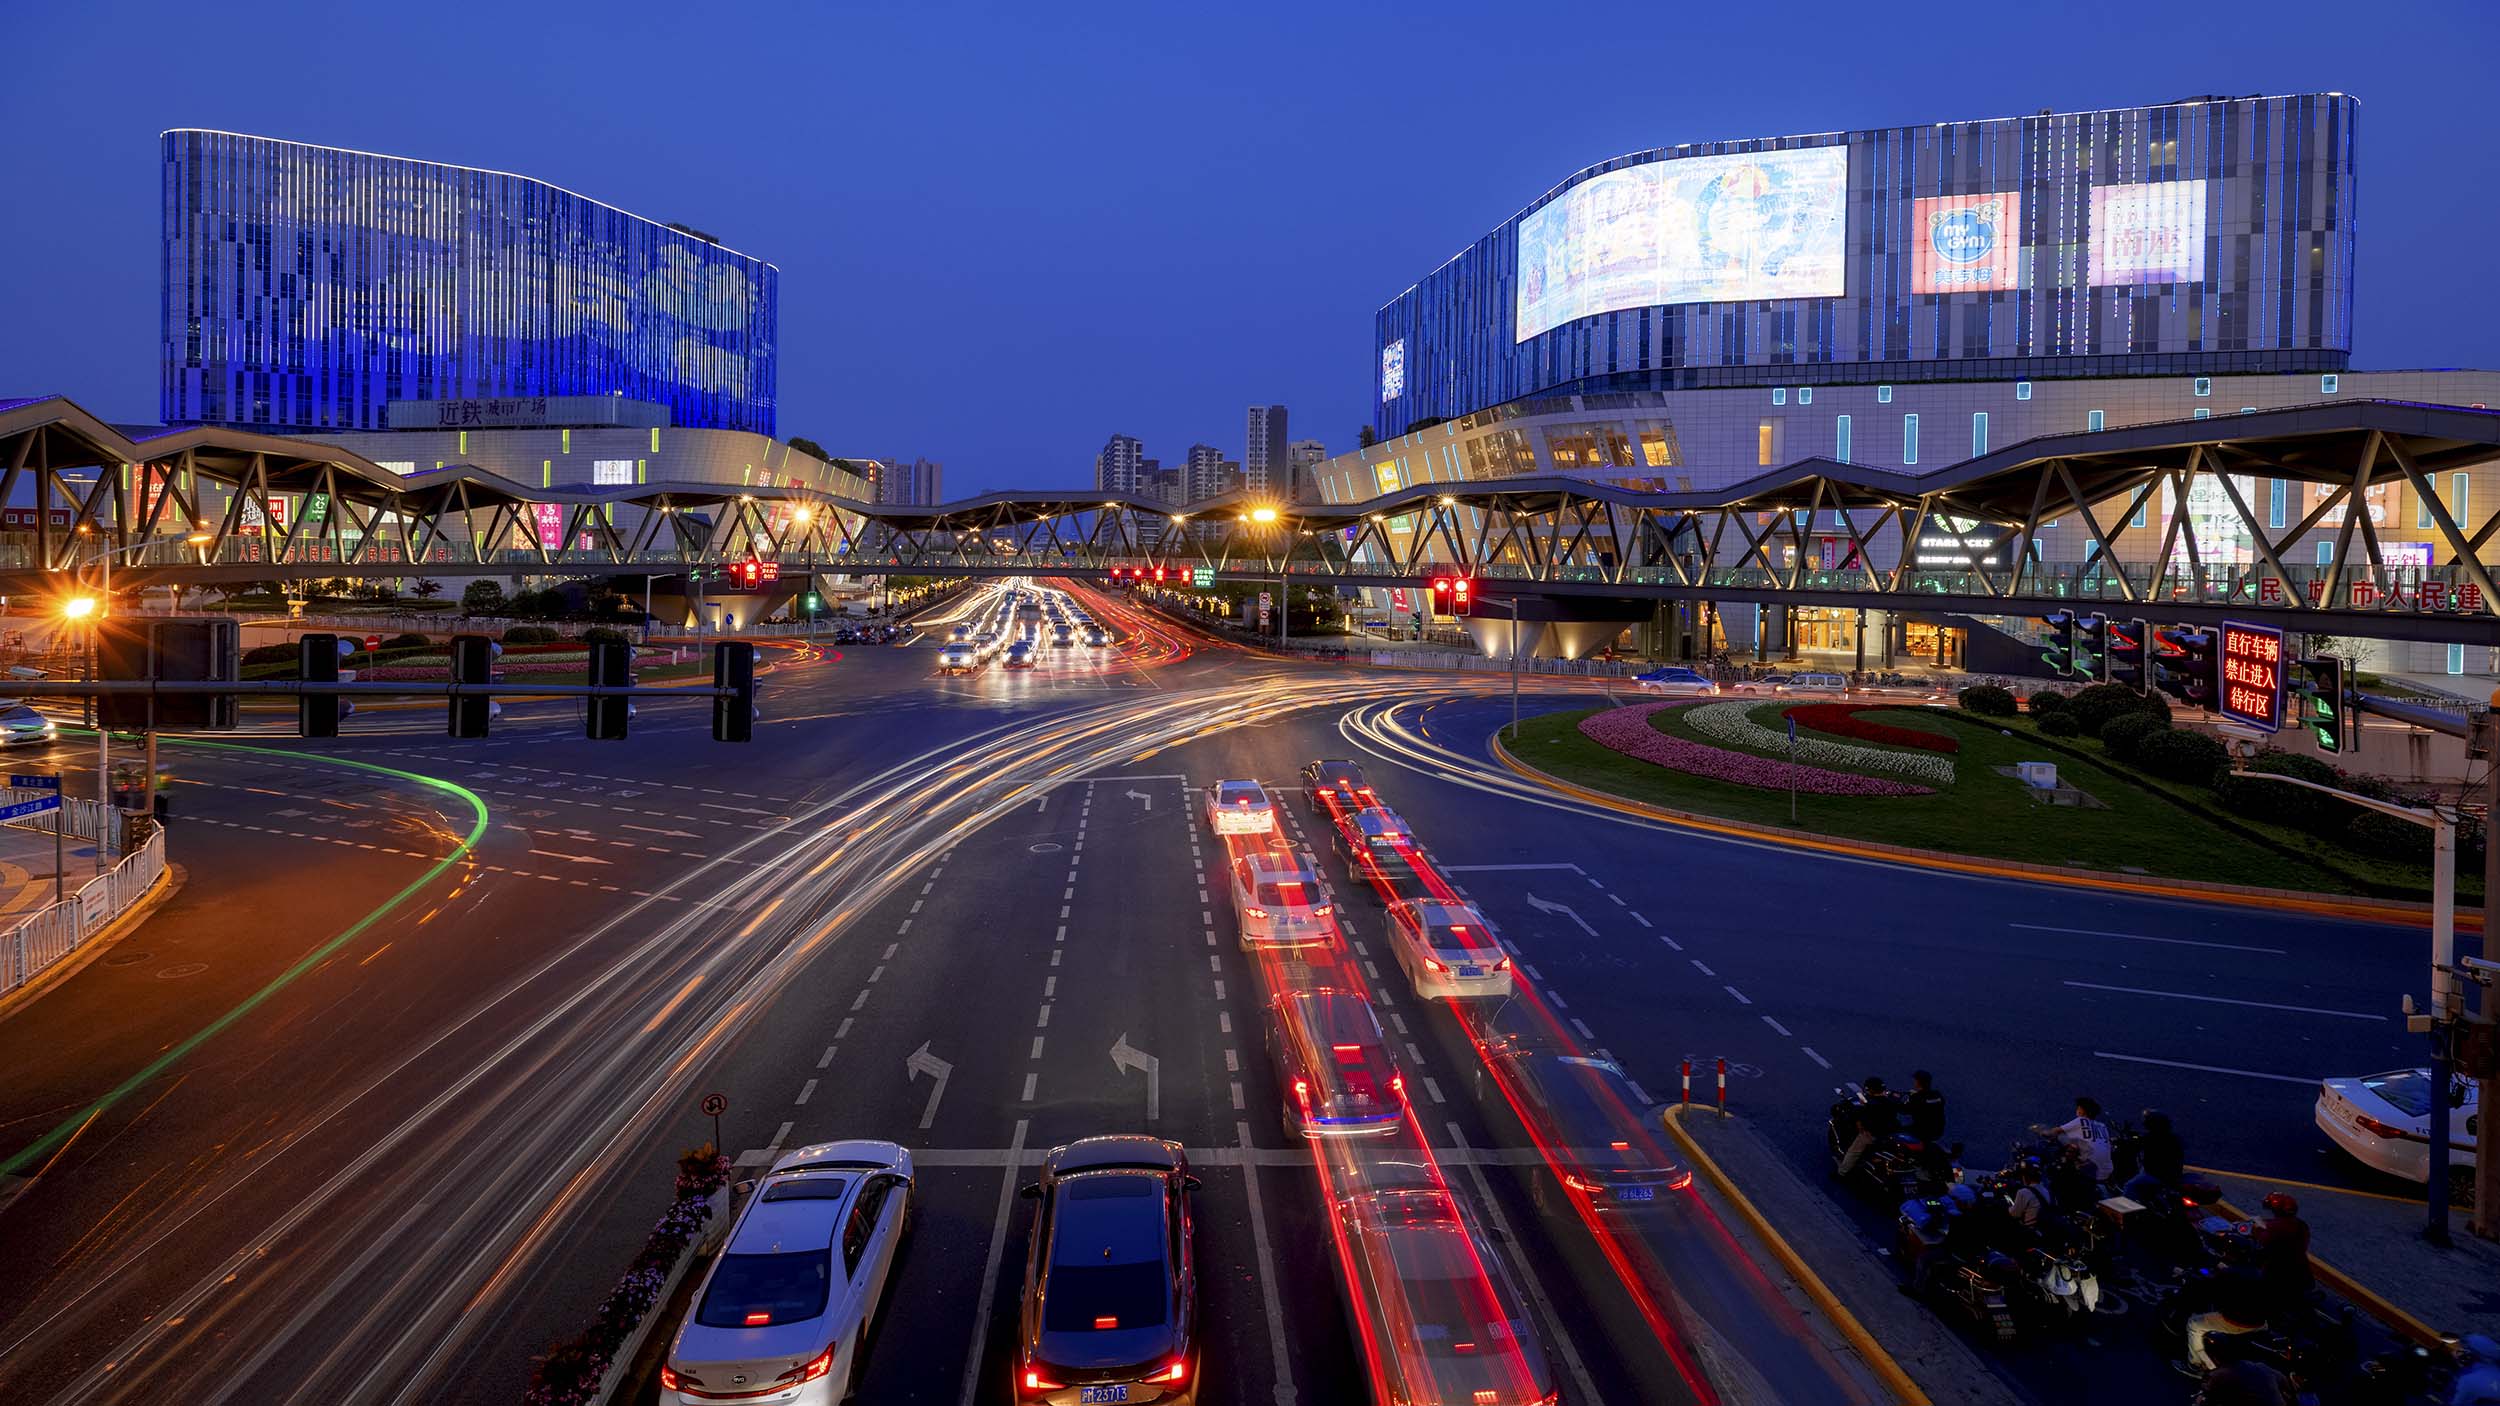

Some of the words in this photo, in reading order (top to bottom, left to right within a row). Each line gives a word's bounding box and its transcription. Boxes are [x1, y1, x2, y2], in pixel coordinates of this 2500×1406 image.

[238, 544, 332, 562] 人民市人民建
[1921, 538, 1991, 548] STARBCKS
[1456, 592, 1467, 602] 08
[2231, 576, 2482, 611] 人民城市人民建
[2226, 632, 2279, 662] 直行车辆
[2225, 658, 2276, 689] 禁止进入
[2231, 686, 2270, 717] 待行区
